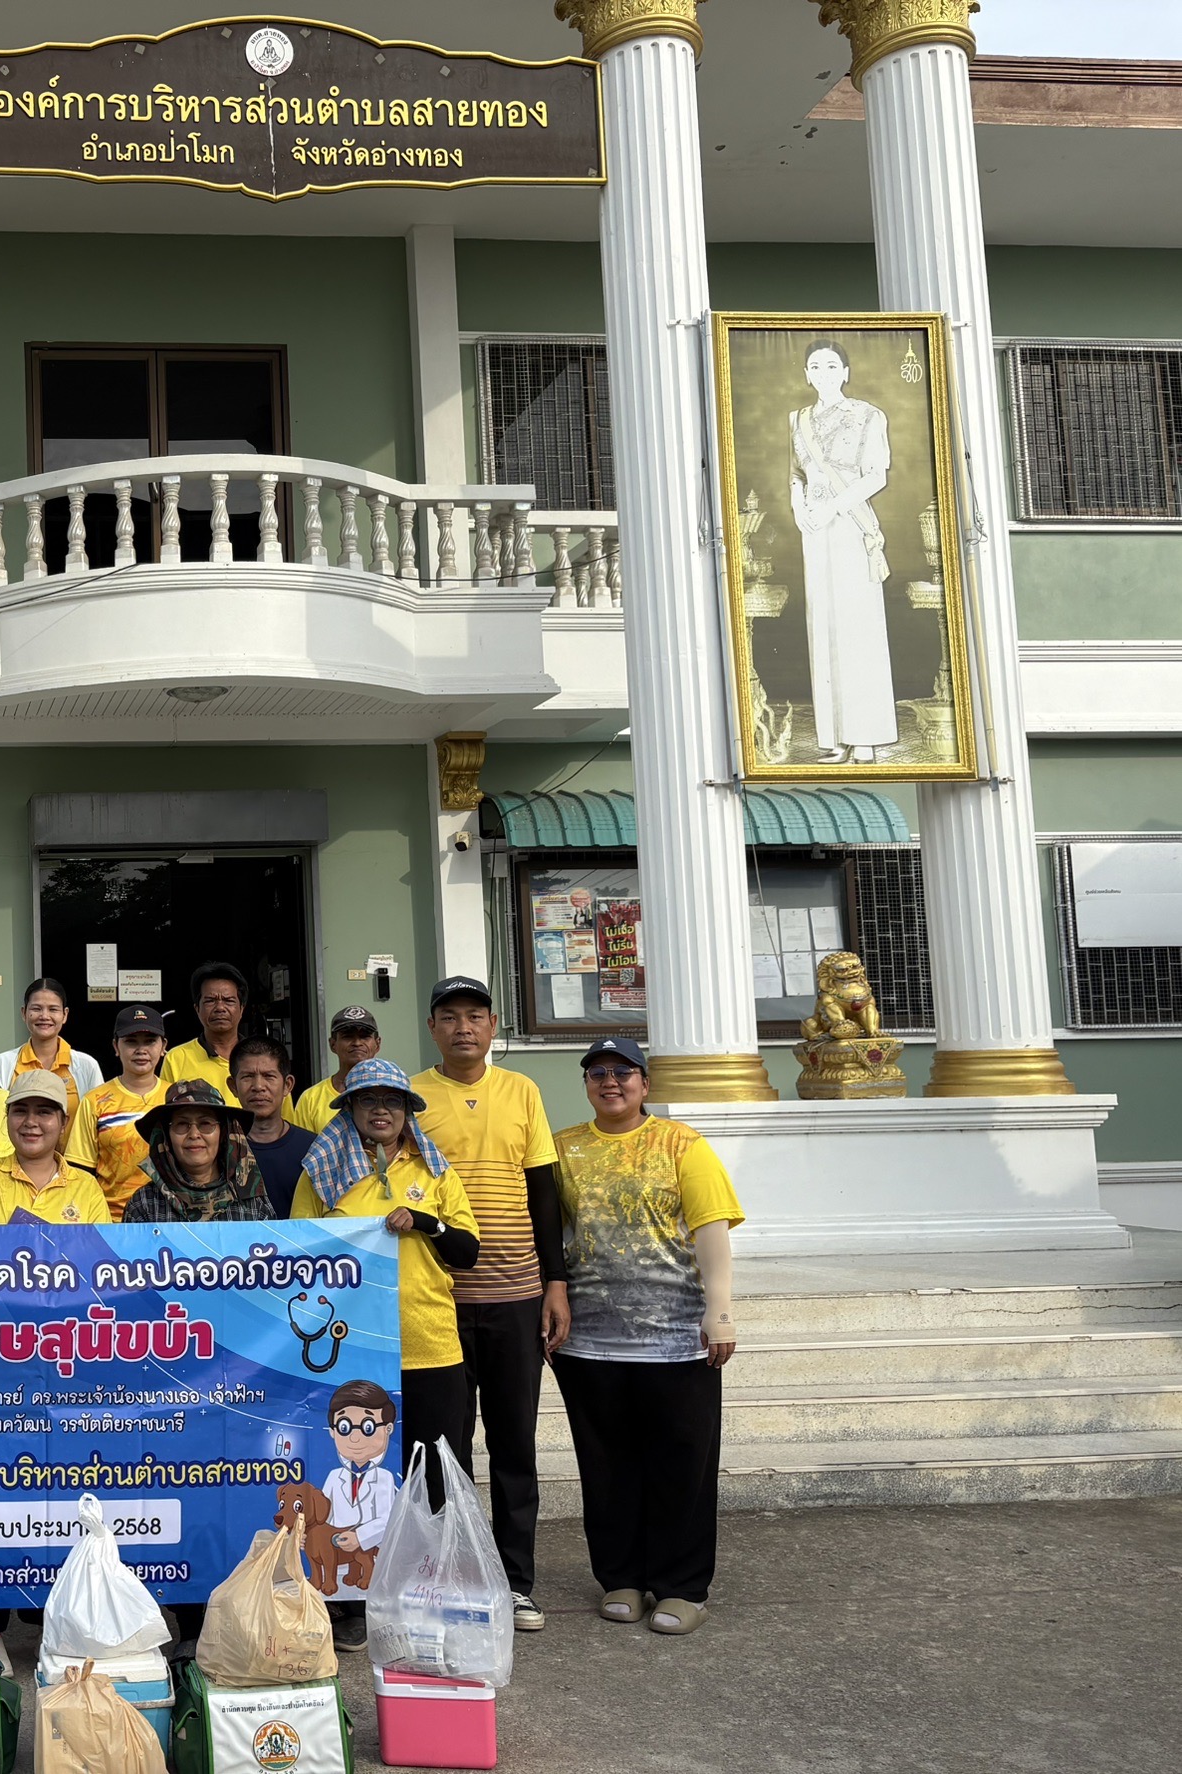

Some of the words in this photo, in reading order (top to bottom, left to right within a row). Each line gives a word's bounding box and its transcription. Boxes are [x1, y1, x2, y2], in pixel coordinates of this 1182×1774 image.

[81, 129, 235, 165] อำเภอป่าโมก
[290, 134, 464, 168] จังหวัดอ่างทอง
[607, 955, 638, 968] ไม่โอน
[96, 1249, 361, 1290] คนปลอดภัยจาก
[31, 1384, 200, 1405] ดร.พระเจ้าน้องนางเธอ
[209, 1383, 265, 1404] เจ้าฟ้าฯ
[59, 1410, 185, 1433] วรขัตติยราชนารี
[113, 1517, 162, 1535] 2568
